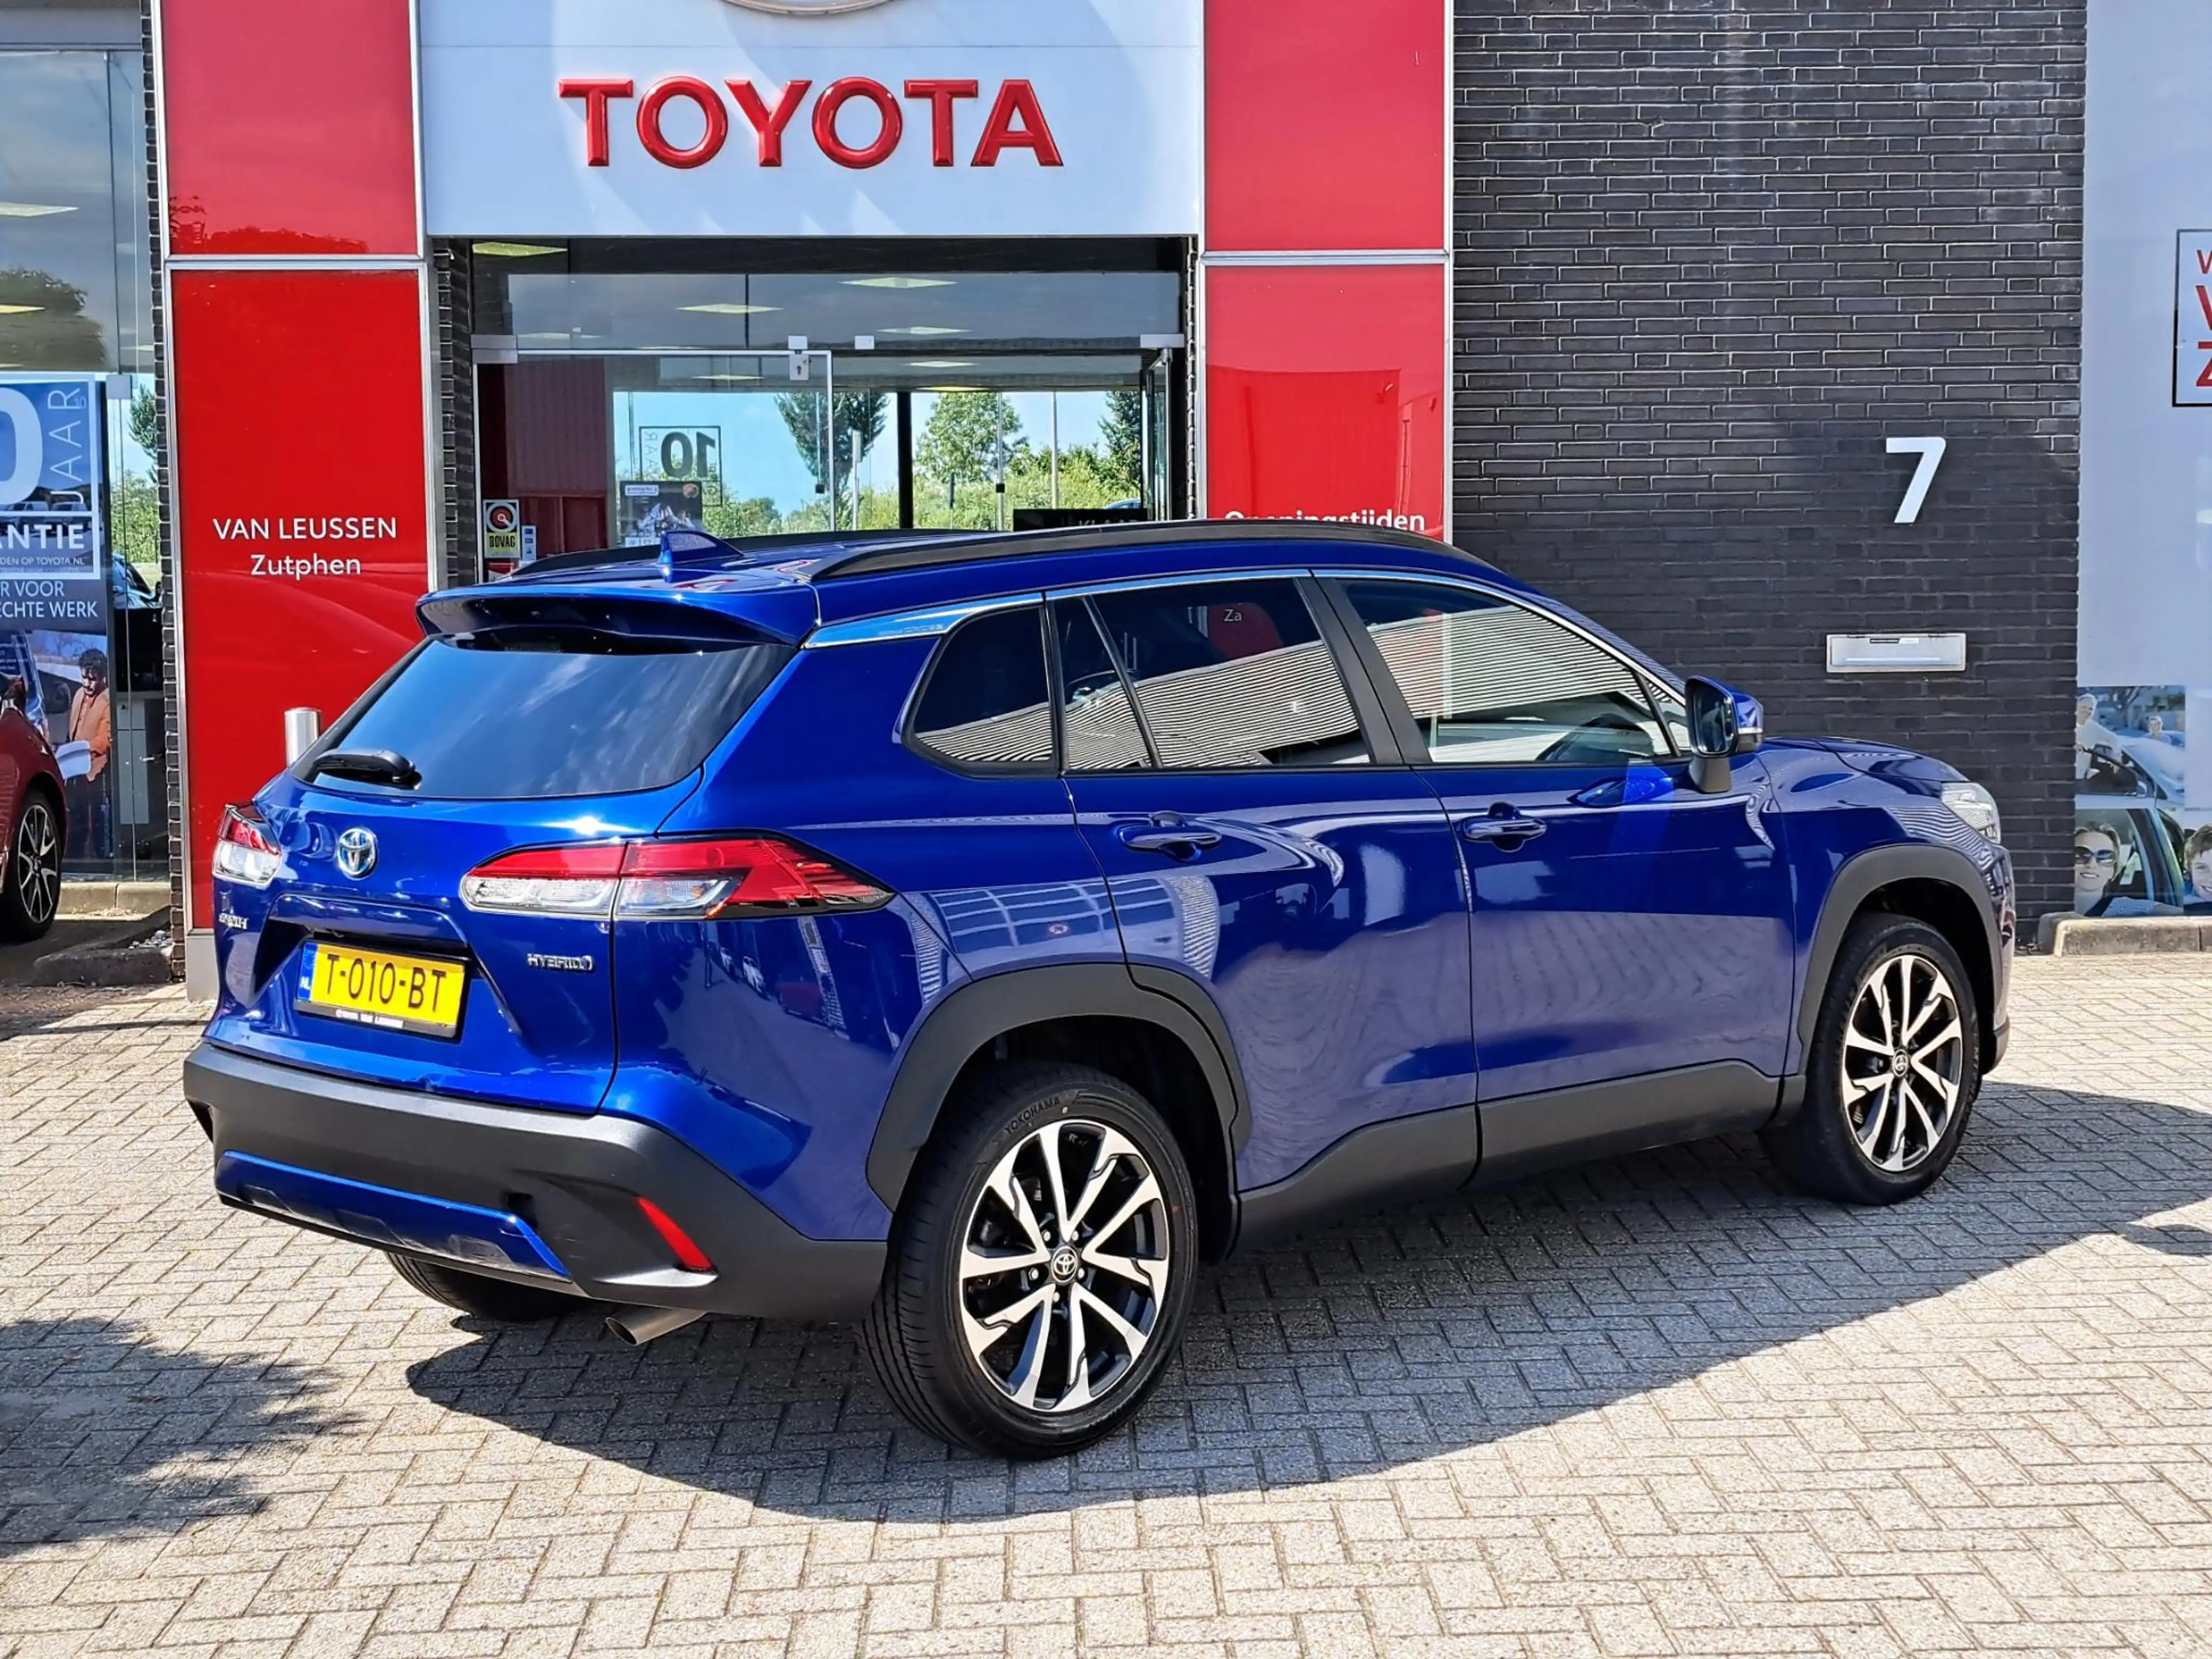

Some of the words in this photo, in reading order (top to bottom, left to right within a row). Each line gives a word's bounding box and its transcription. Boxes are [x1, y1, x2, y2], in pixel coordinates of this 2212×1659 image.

[558, 75, 1065, 169] TOYOTA
[47, 388, 84, 505] JAAR
[1885, 436, 1946, 524] 7
[0, 524, 85, 550] NTIE
[213, 518, 269, 540] VAN
[279, 517, 396, 539] LEUSSEN
[488, 535, 516, 548] BOVAG
[21, 556, 34, 565] OP
[251, 553, 361, 580] Zutphen
[14, 580, 65, 597] VOOR
[0, 601, 44, 618] CHTE
[49, 601, 99, 618] WERK
[1224, 609, 1243, 622] Za
[527, 953, 584, 969] HYBRID
[327, 953, 447, 1012] T-010-BT
[1004, 1096, 1061, 1134] YOKOHAMA
